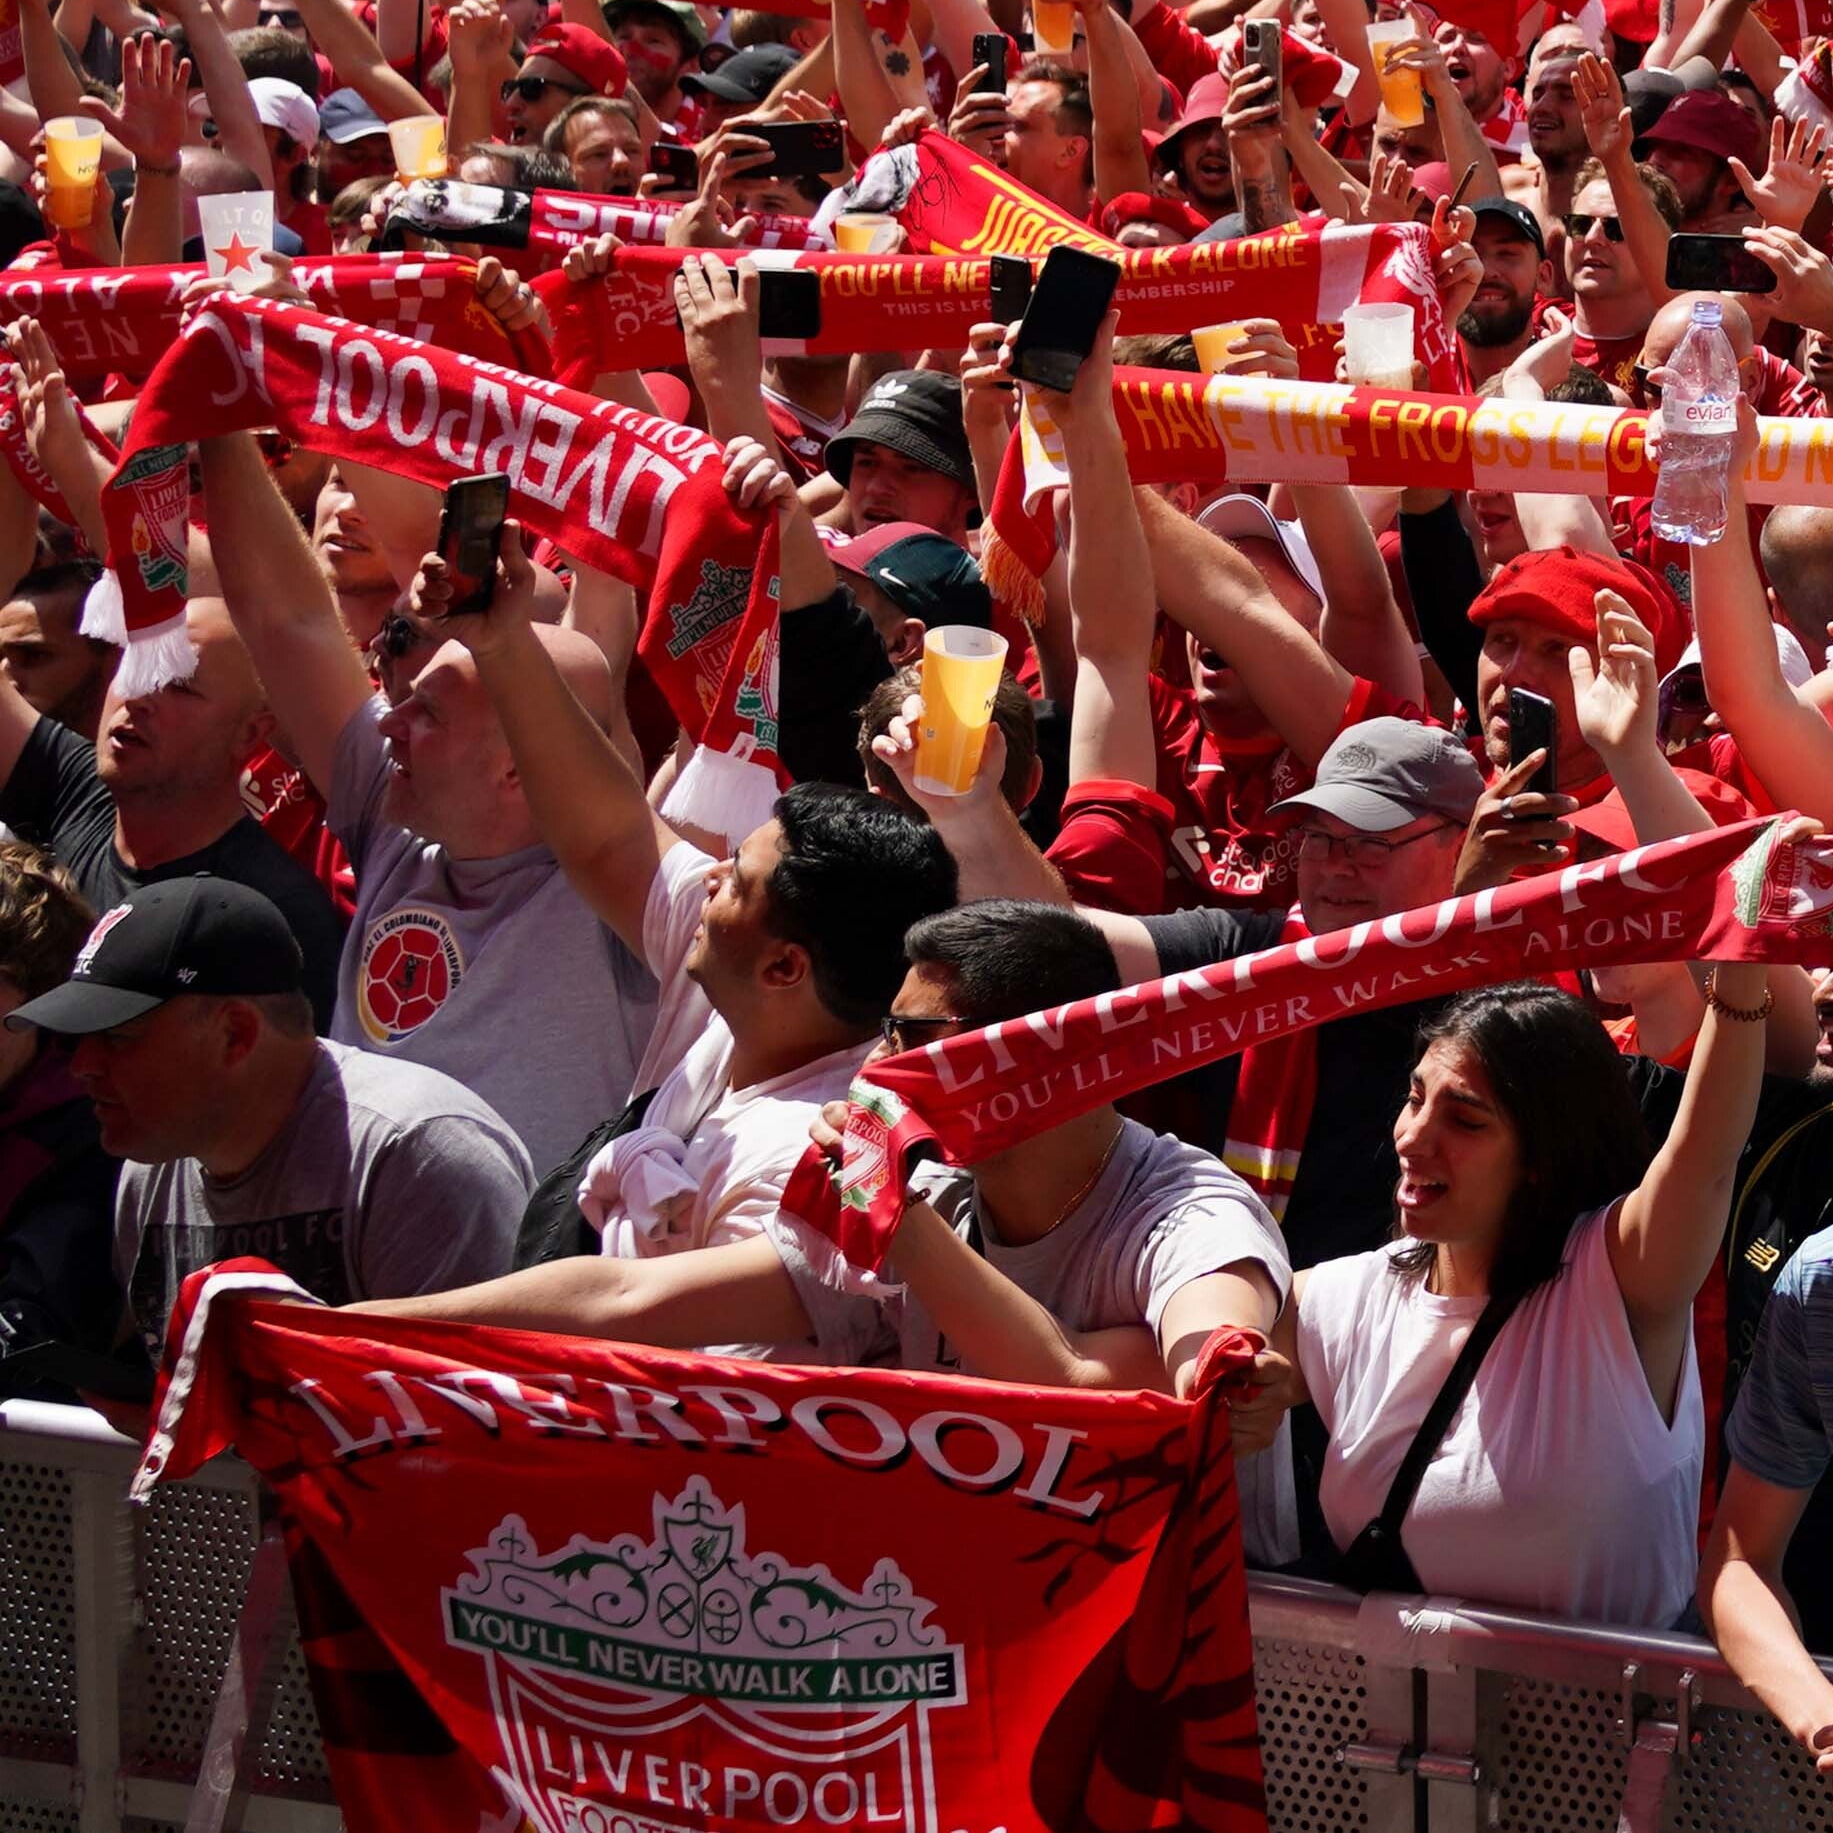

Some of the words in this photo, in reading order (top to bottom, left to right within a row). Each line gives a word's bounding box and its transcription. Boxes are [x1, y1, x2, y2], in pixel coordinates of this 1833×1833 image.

[816, 262, 934, 300] YOU'LL
[1189, 232, 1313, 278] ALONE
[882, 300, 936, 317] THIS
[942, 299, 963, 314] IS
[1108, 278, 1237, 306] EMBERSHIP
[297, 323, 690, 561] LIVERPOOL
[1129, 381, 1260, 453] HAVE
[1261, 390, 1358, 459] THE
[1369, 398, 1536, 469] FROGS
[1684, 401, 1737, 423] evian
[926, 888, 1524, 1094] LIVERPOOL
[958, 1059, 1124, 1135] YOU'LL
[1151, 993, 1318, 1064] NEVER
[1522, 909, 1687, 961] ALONE
[288, 1368, 1107, 1522] LIVERPOOL
[458, 1604, 581, 1667] YOU'LL
[588, 1632, 707, 1693] NEVER
[708, 1660, 814, 1699] WALK
[828, 1656, 951, 1697] ALONE
[533, 1726, 904, 1829] LIVERPOOL
